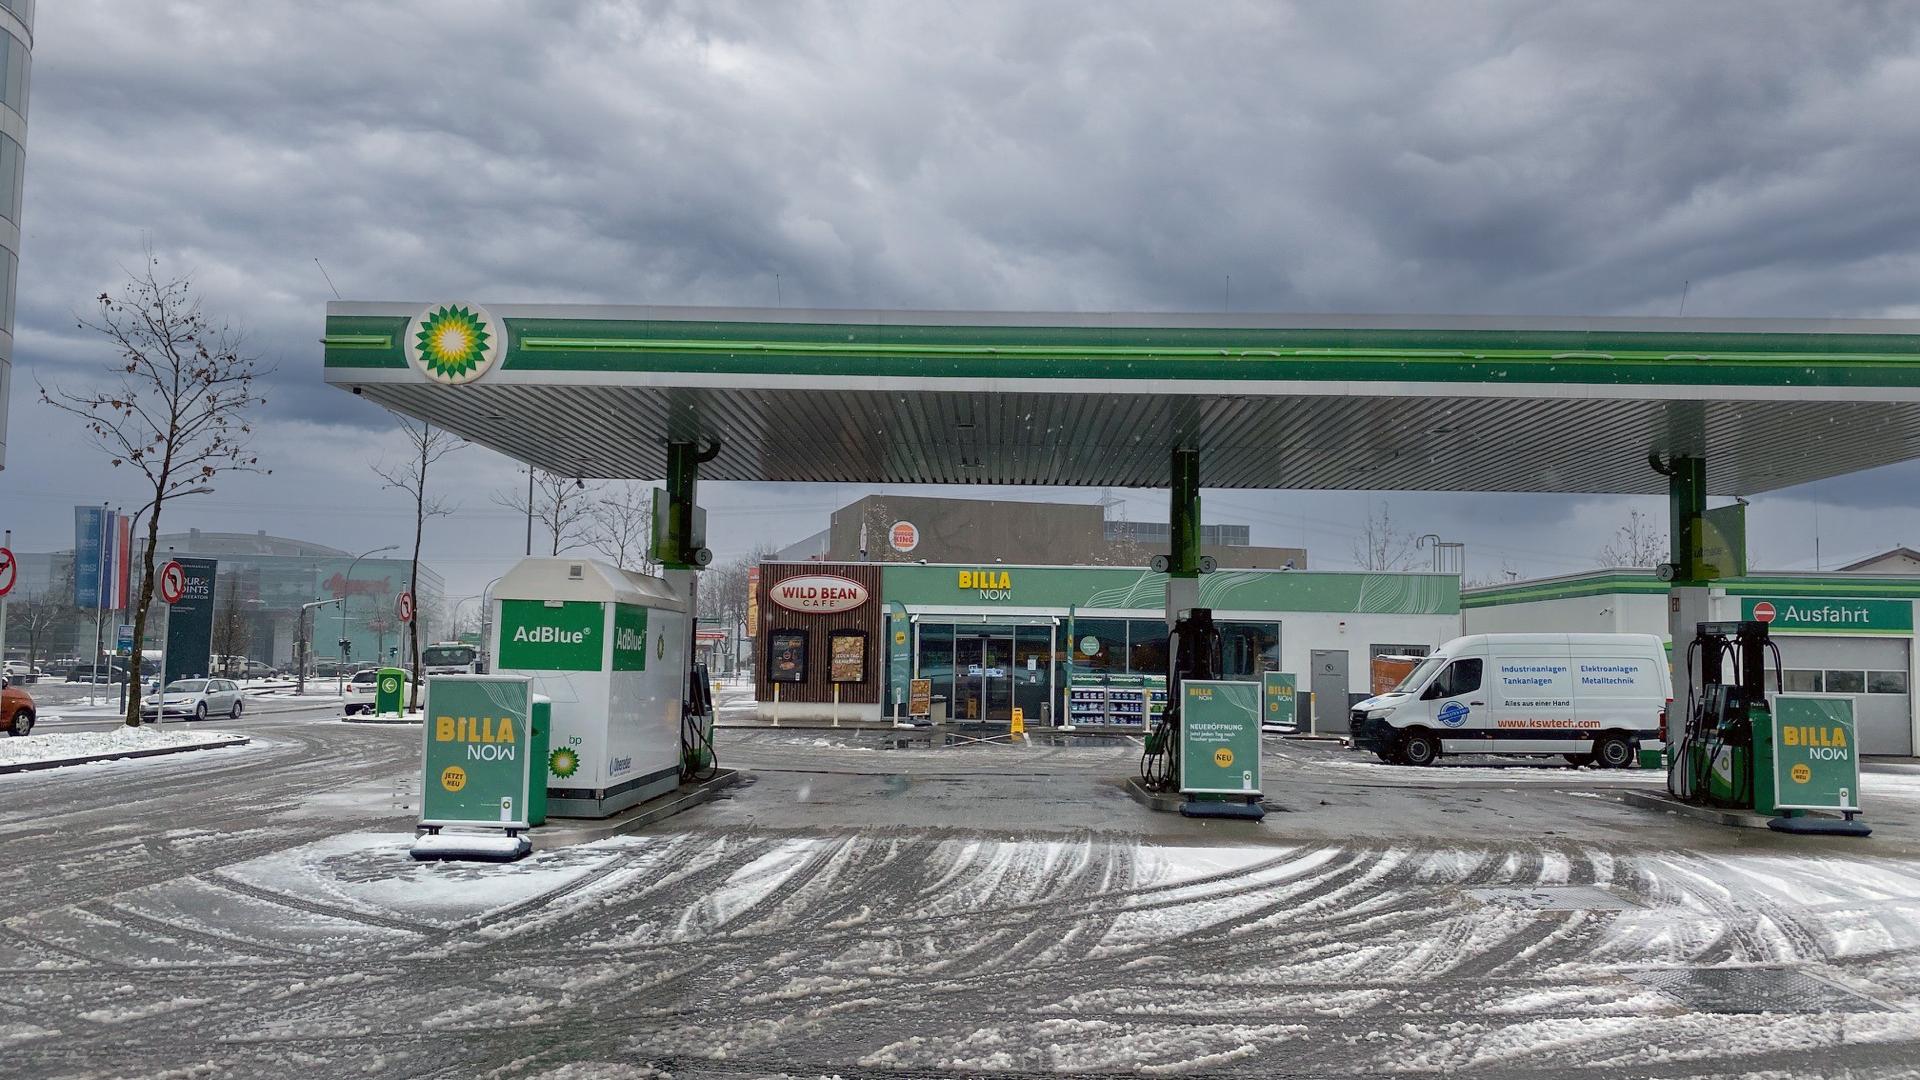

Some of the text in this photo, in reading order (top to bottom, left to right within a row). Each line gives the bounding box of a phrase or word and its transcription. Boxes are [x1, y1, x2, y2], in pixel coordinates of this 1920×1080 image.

[700, 551, 707, 562] 5
[1156, 560, 1162, 569] 4
[1204, 560, 1211, 570] 3
[1662, 567, 1668, 578] 2
[959, 570, 1011, 589] BILLA
[782, 586, 857, 600] WILD BEAN
[980, 589, 1011, 600] NOW
[1784, 605, 1870, 623] Ausfahrt
[1501, 665, 1567, 674] Industrieanlagen
[1580, 665, 1639, 674] Elektroanlagen
[1503, 677, 1553, 686] Tankanlagen
[1581, 677, 1634, 685] Metalltechnik
[1189, 688, 1213, 696] BILLA
[1268, 686, 1292, 695] BILLA
[1190, 722, 1243, 731] NEUERÖFFNUNG
[1497, 718, 1601, 728] www.kswtech.com
[436, 716, 515, 743] BILLA
[568, 734, 582, 746] bp
[1783, 726, 1847, 747] BILLA
[467, 744, 515, 761] NOW
[1809, 747, 1848, 761] NOW
[1216, 754, 1232, 762] NEU
[444, 772, 463, 780] JETZT
